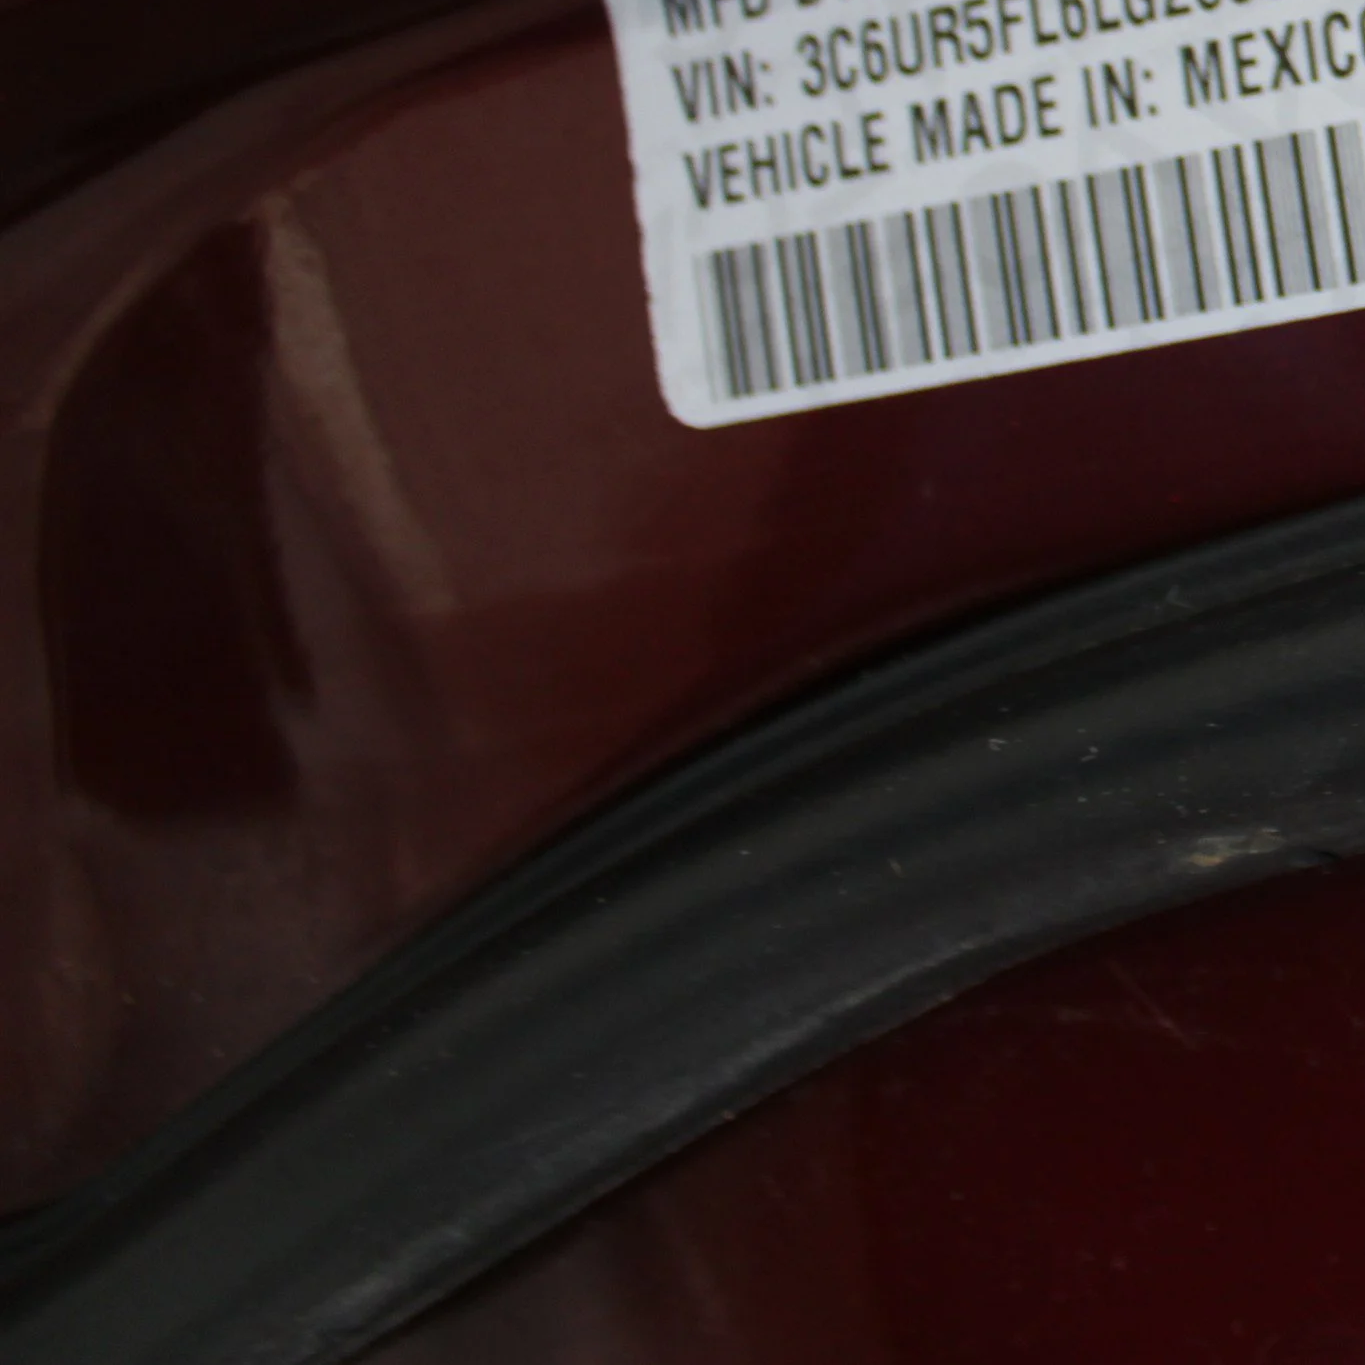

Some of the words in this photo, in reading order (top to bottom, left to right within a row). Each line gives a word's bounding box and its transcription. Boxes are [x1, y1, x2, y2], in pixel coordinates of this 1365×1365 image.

[672, 53, 772, 123] VIN:
[683, 111, 890, 209] VEHICLE
[910, 74, 1062, 163] MADE
[1083, 59, 1157, 128] IN:
